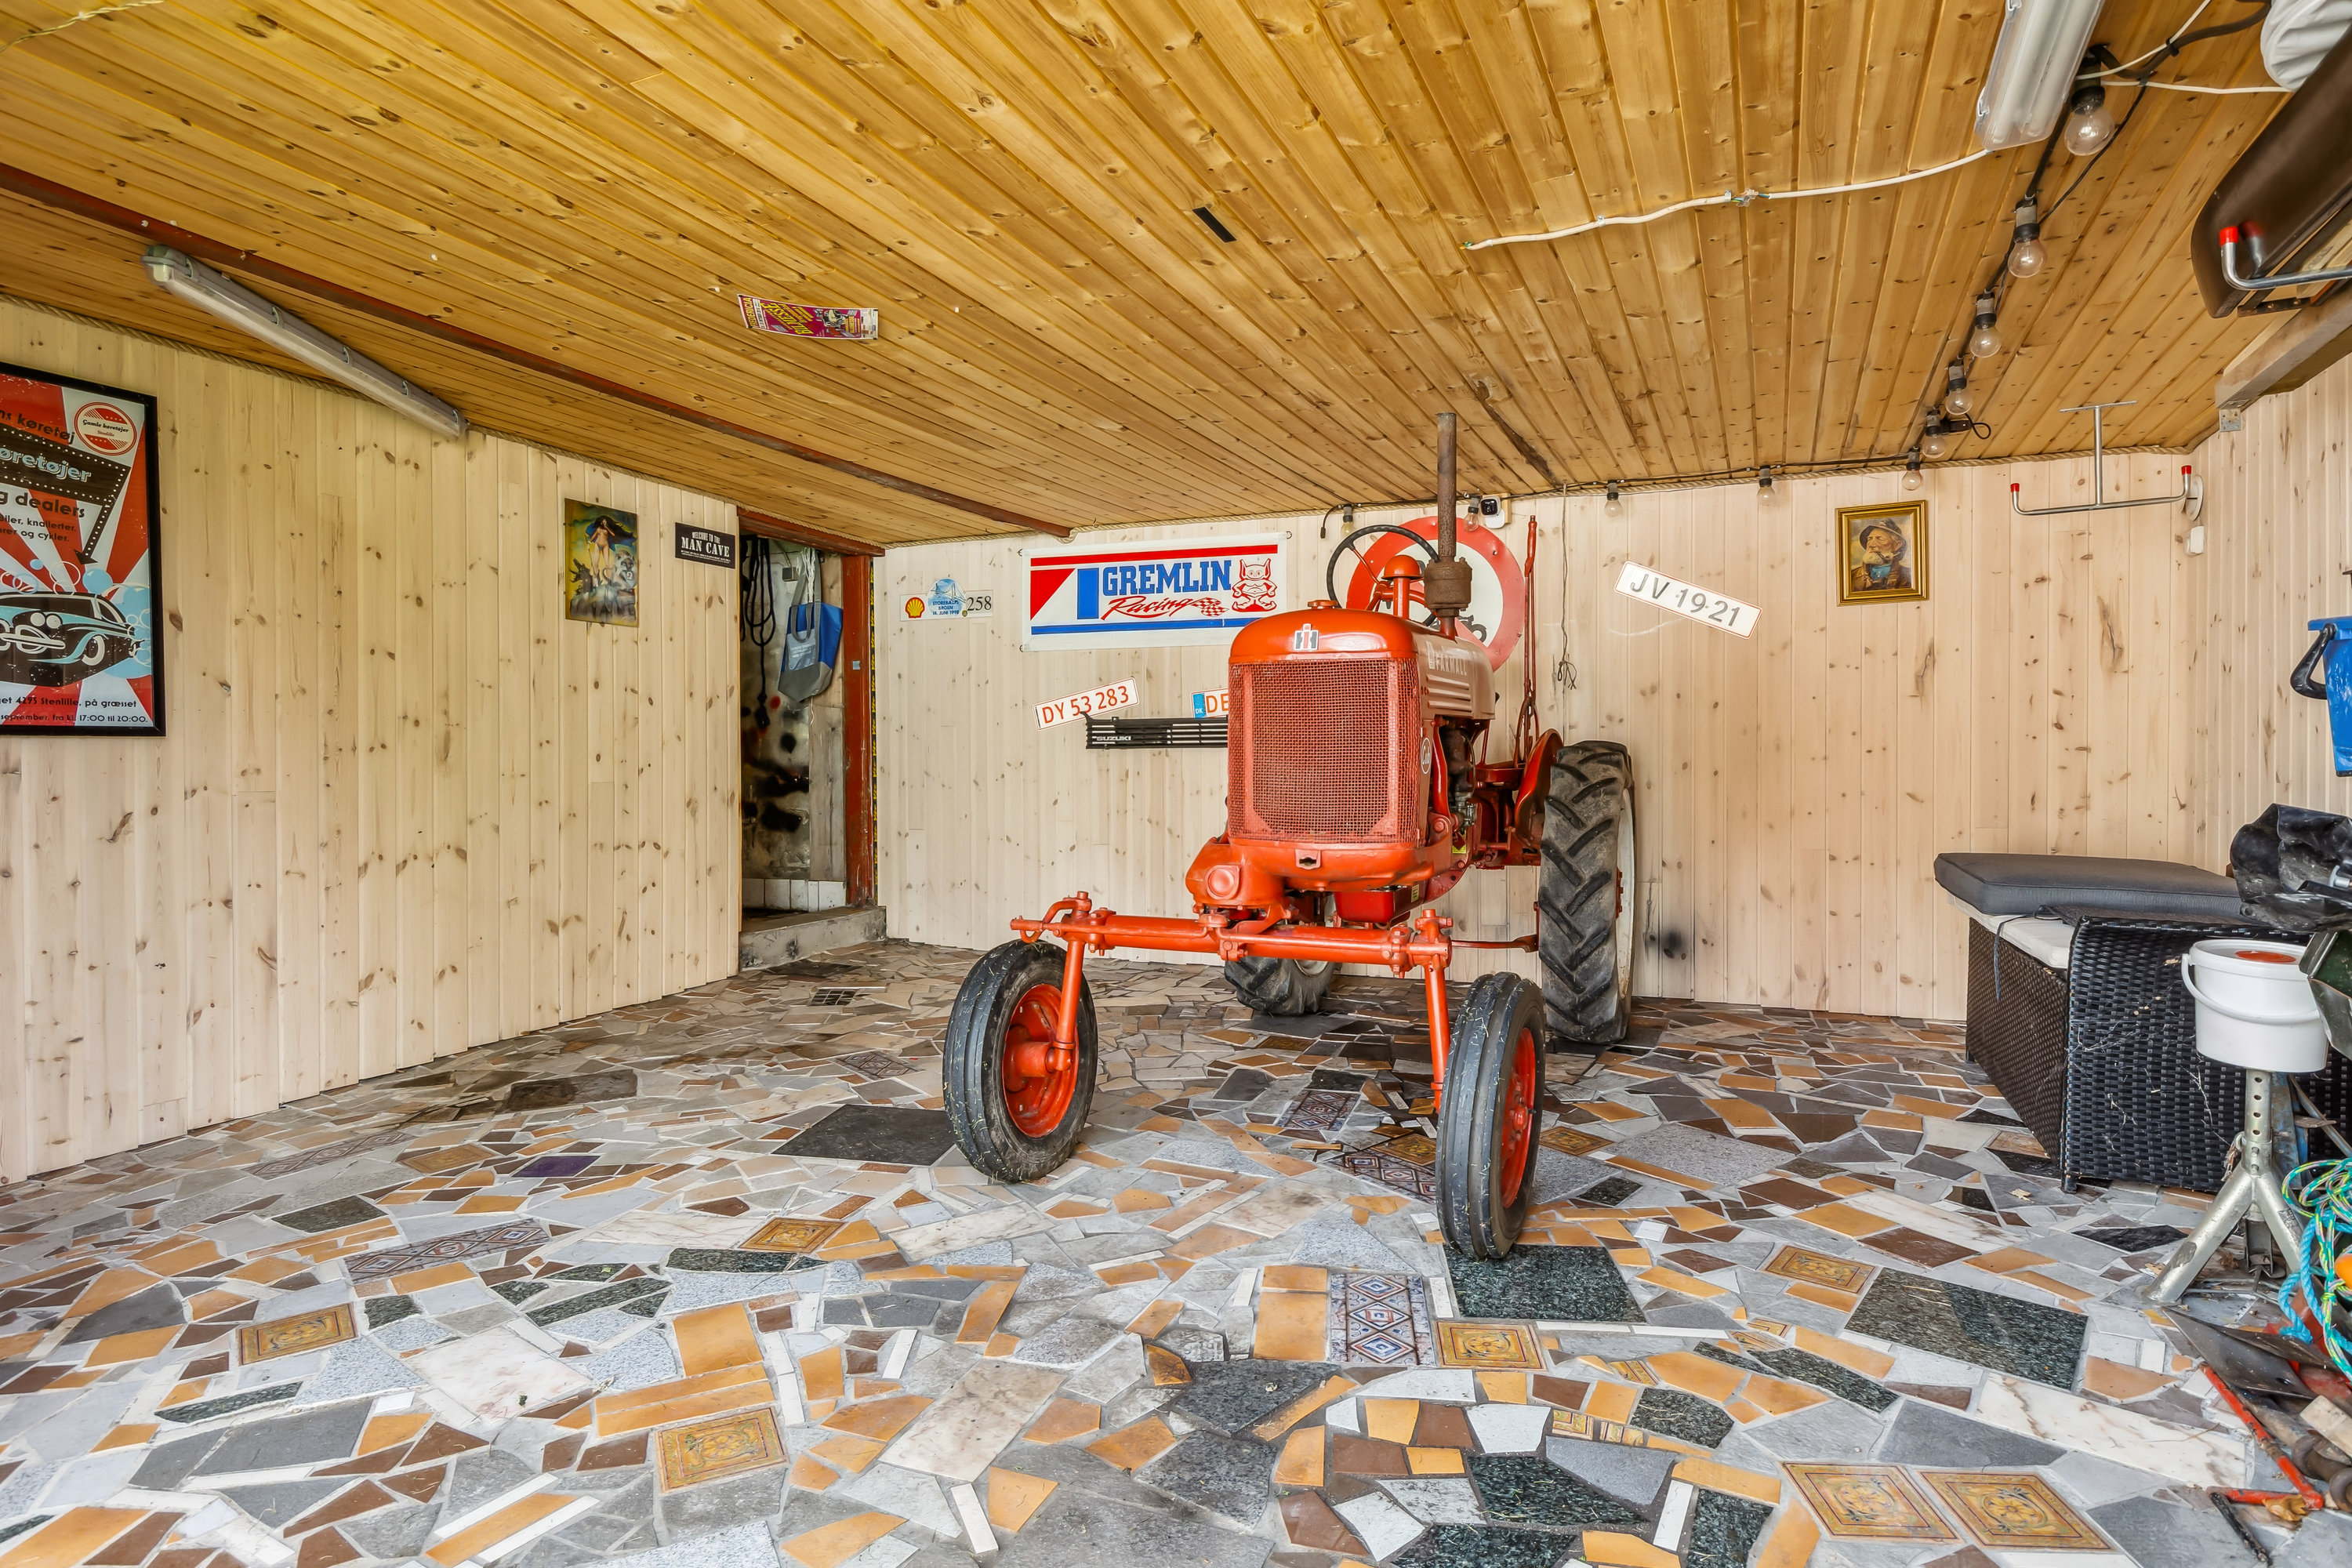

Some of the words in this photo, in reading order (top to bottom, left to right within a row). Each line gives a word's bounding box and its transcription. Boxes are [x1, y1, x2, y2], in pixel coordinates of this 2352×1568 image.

[742, 297, 759, 328] FREDERICIA
[760, 303, 814, 335] BILMESSE
[17, 412, 75, 445] køretøj
[102, 423, 129, 433] køretøjer
[15, 492, 85, 518] dealers
[20, 530, 34, 539] og
[38, 532, 69, 542] cykler.
[681, 536, 702, 552] MAN
[706, 542, 730, 557] CAVE
[691, 532, 709, 541] WELCOME
[709, 534, 713, 543] TO
[1102, 560, 1232, 597] GREMLIN
[1630, 573, 1671, 601] JV
[967, 596, 992, 612] 258
[1100, 595, 1195, 620] Racing
[85, 699, 98, 708] på
[1042, 702, 1064, 724] DY
[1070, 695, 1092, 717] 53
[1095, 685, 1129, 710] 283
